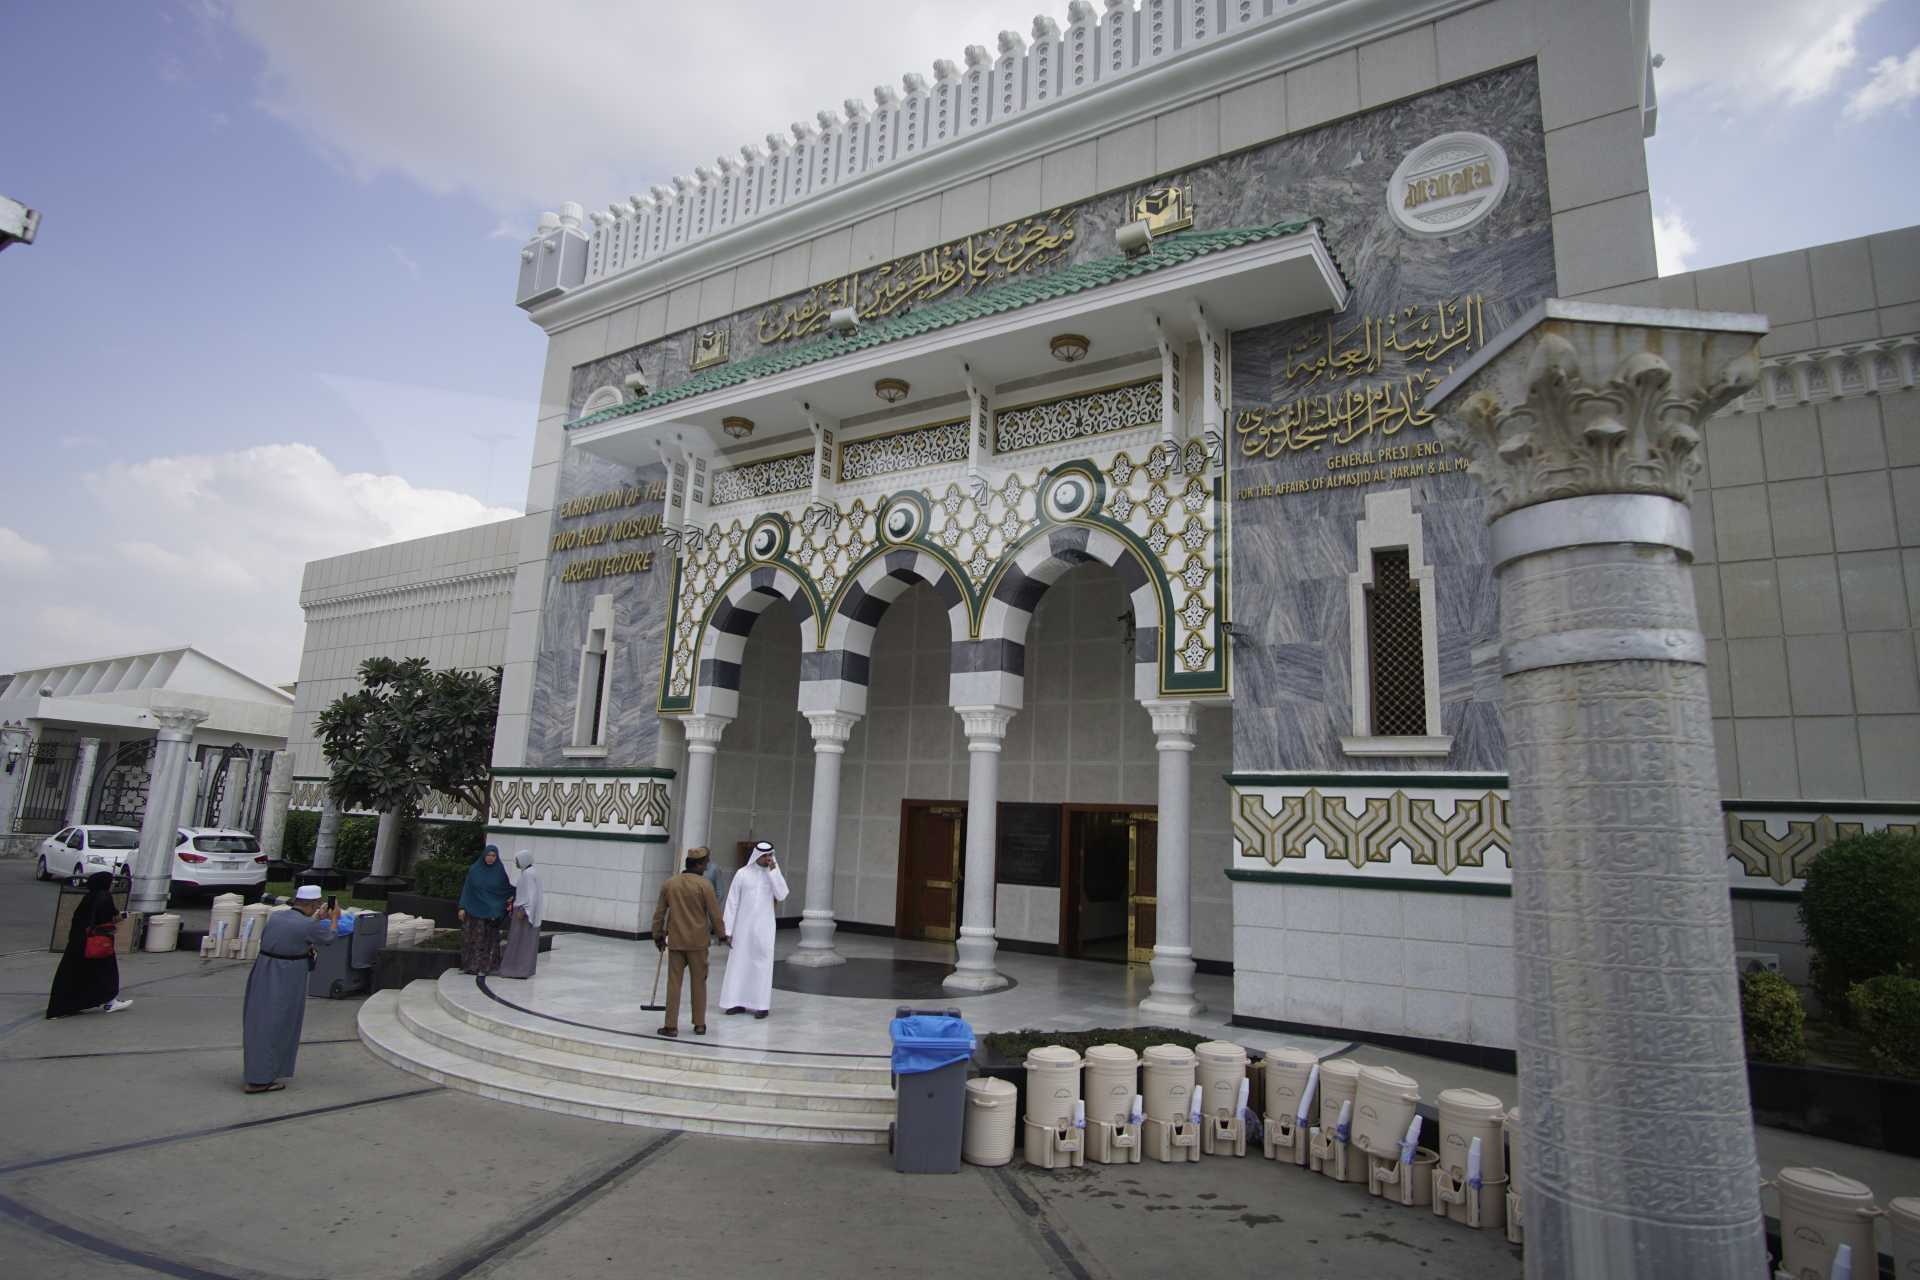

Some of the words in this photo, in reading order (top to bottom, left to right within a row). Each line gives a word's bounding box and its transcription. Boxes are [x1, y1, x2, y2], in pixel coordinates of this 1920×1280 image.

[1327, 453, 1376, 470] GENERAL
[1237, 487, 1254, 501] FOR
[1257, 482, 1272, 497] THE
[1275, 478, 1310, 495] AFFAIRS
[1312, 476, 1327, 491] OF
[1327, 471, 1370, 488] ALMASJID
[1373, 469, 1387, 483] AL
[1390, 463, 1424, 480] HARAM
[1428, 461, 1436, 474] &
[1439, 459, 1451, 472] AL
[560, 488, 623, 520] EXHIBITION
[623, 486, 640, 506] OF
[644, 480, 667, 500] THE
[552, 529, 576, 552] TWO
[577, 522, 608, 546] HOLY
[560, 551, 651, 583] ARCHITECTURE
